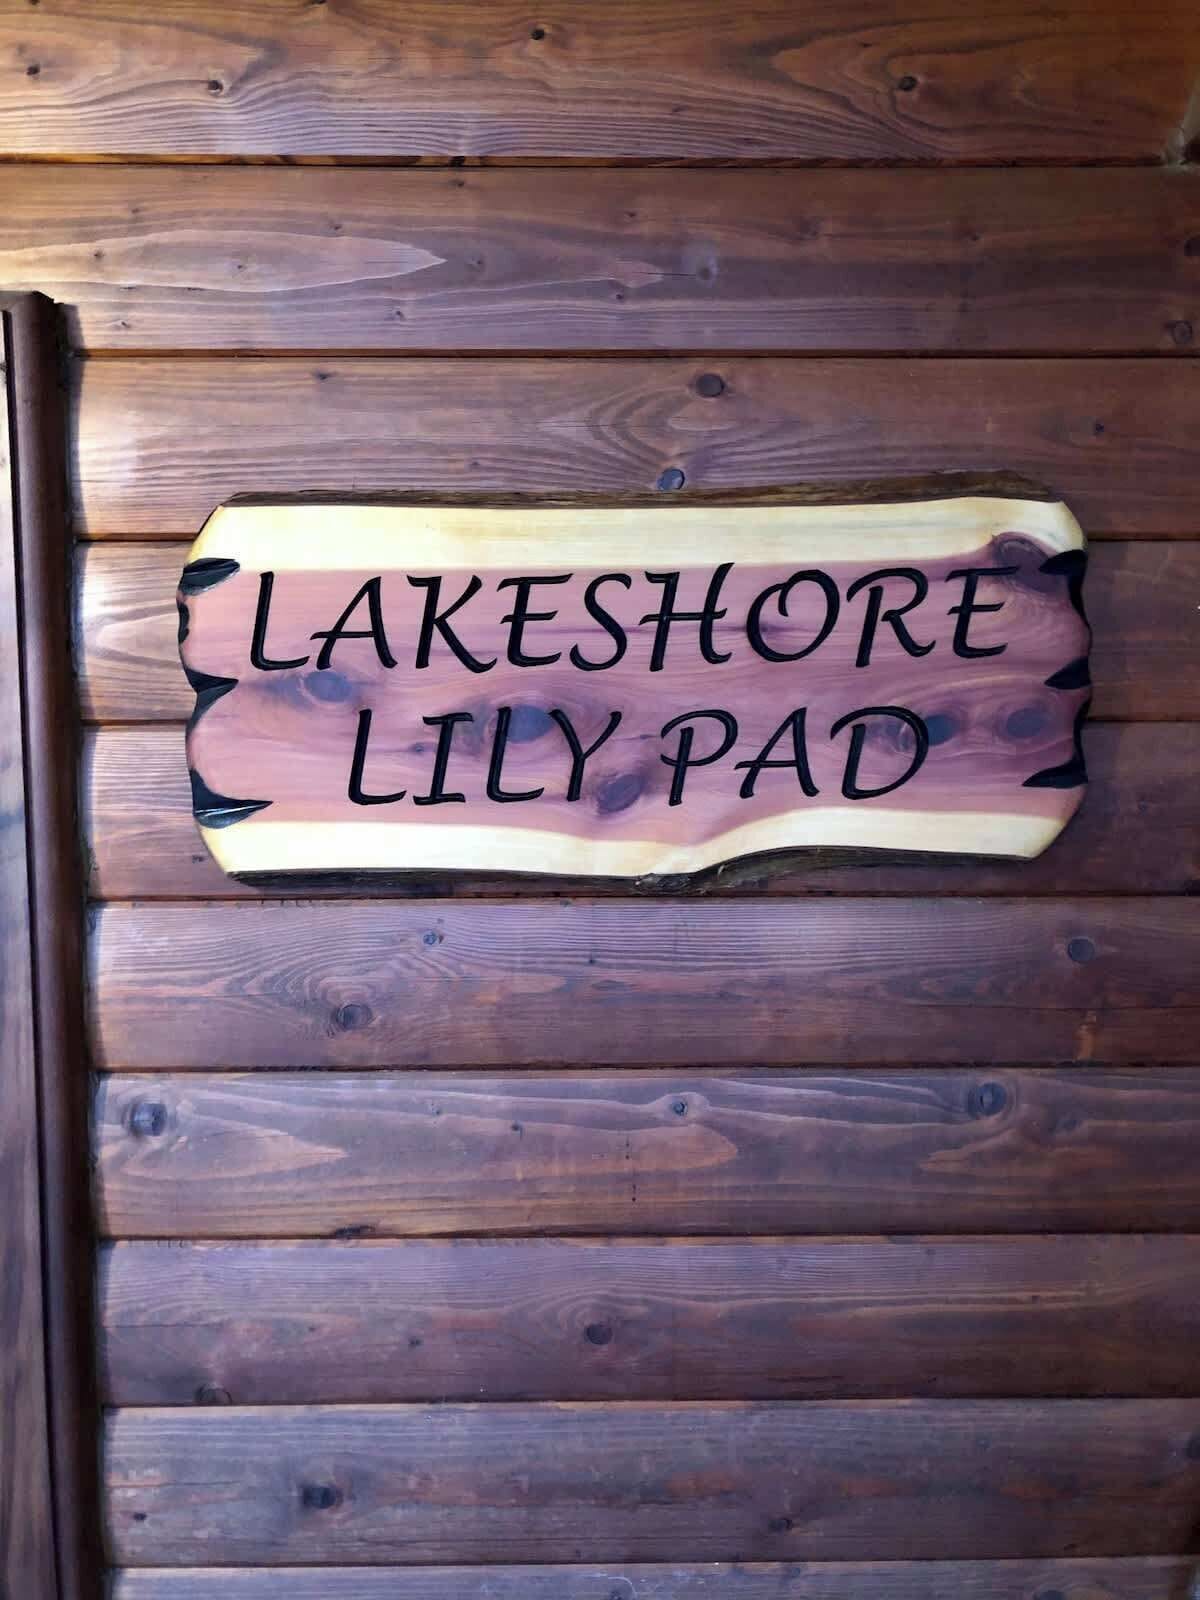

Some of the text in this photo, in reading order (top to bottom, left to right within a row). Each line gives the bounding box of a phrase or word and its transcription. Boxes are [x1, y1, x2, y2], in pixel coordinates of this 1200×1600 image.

[250, 562, 1014, 674] LAKESHORE
[348, 706, 930, 806] LILY PAD
